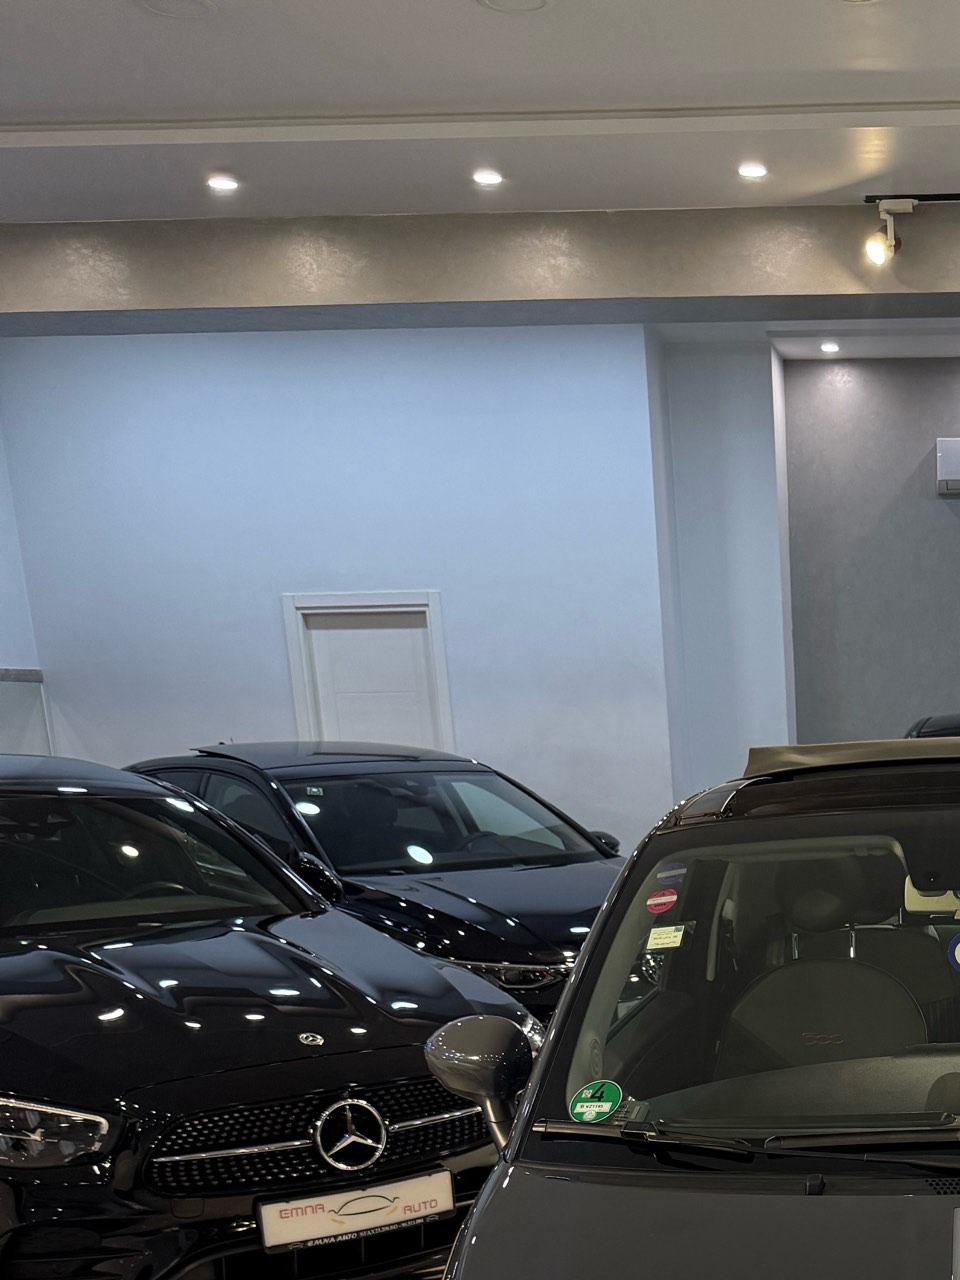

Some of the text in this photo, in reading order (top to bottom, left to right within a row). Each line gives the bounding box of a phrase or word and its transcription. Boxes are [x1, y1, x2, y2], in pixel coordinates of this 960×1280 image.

[590, 1083, 606, 1103] 4
[279, 1203, 326, 1220] EMNA
[403, 1199, 439, 1216] AUTO
